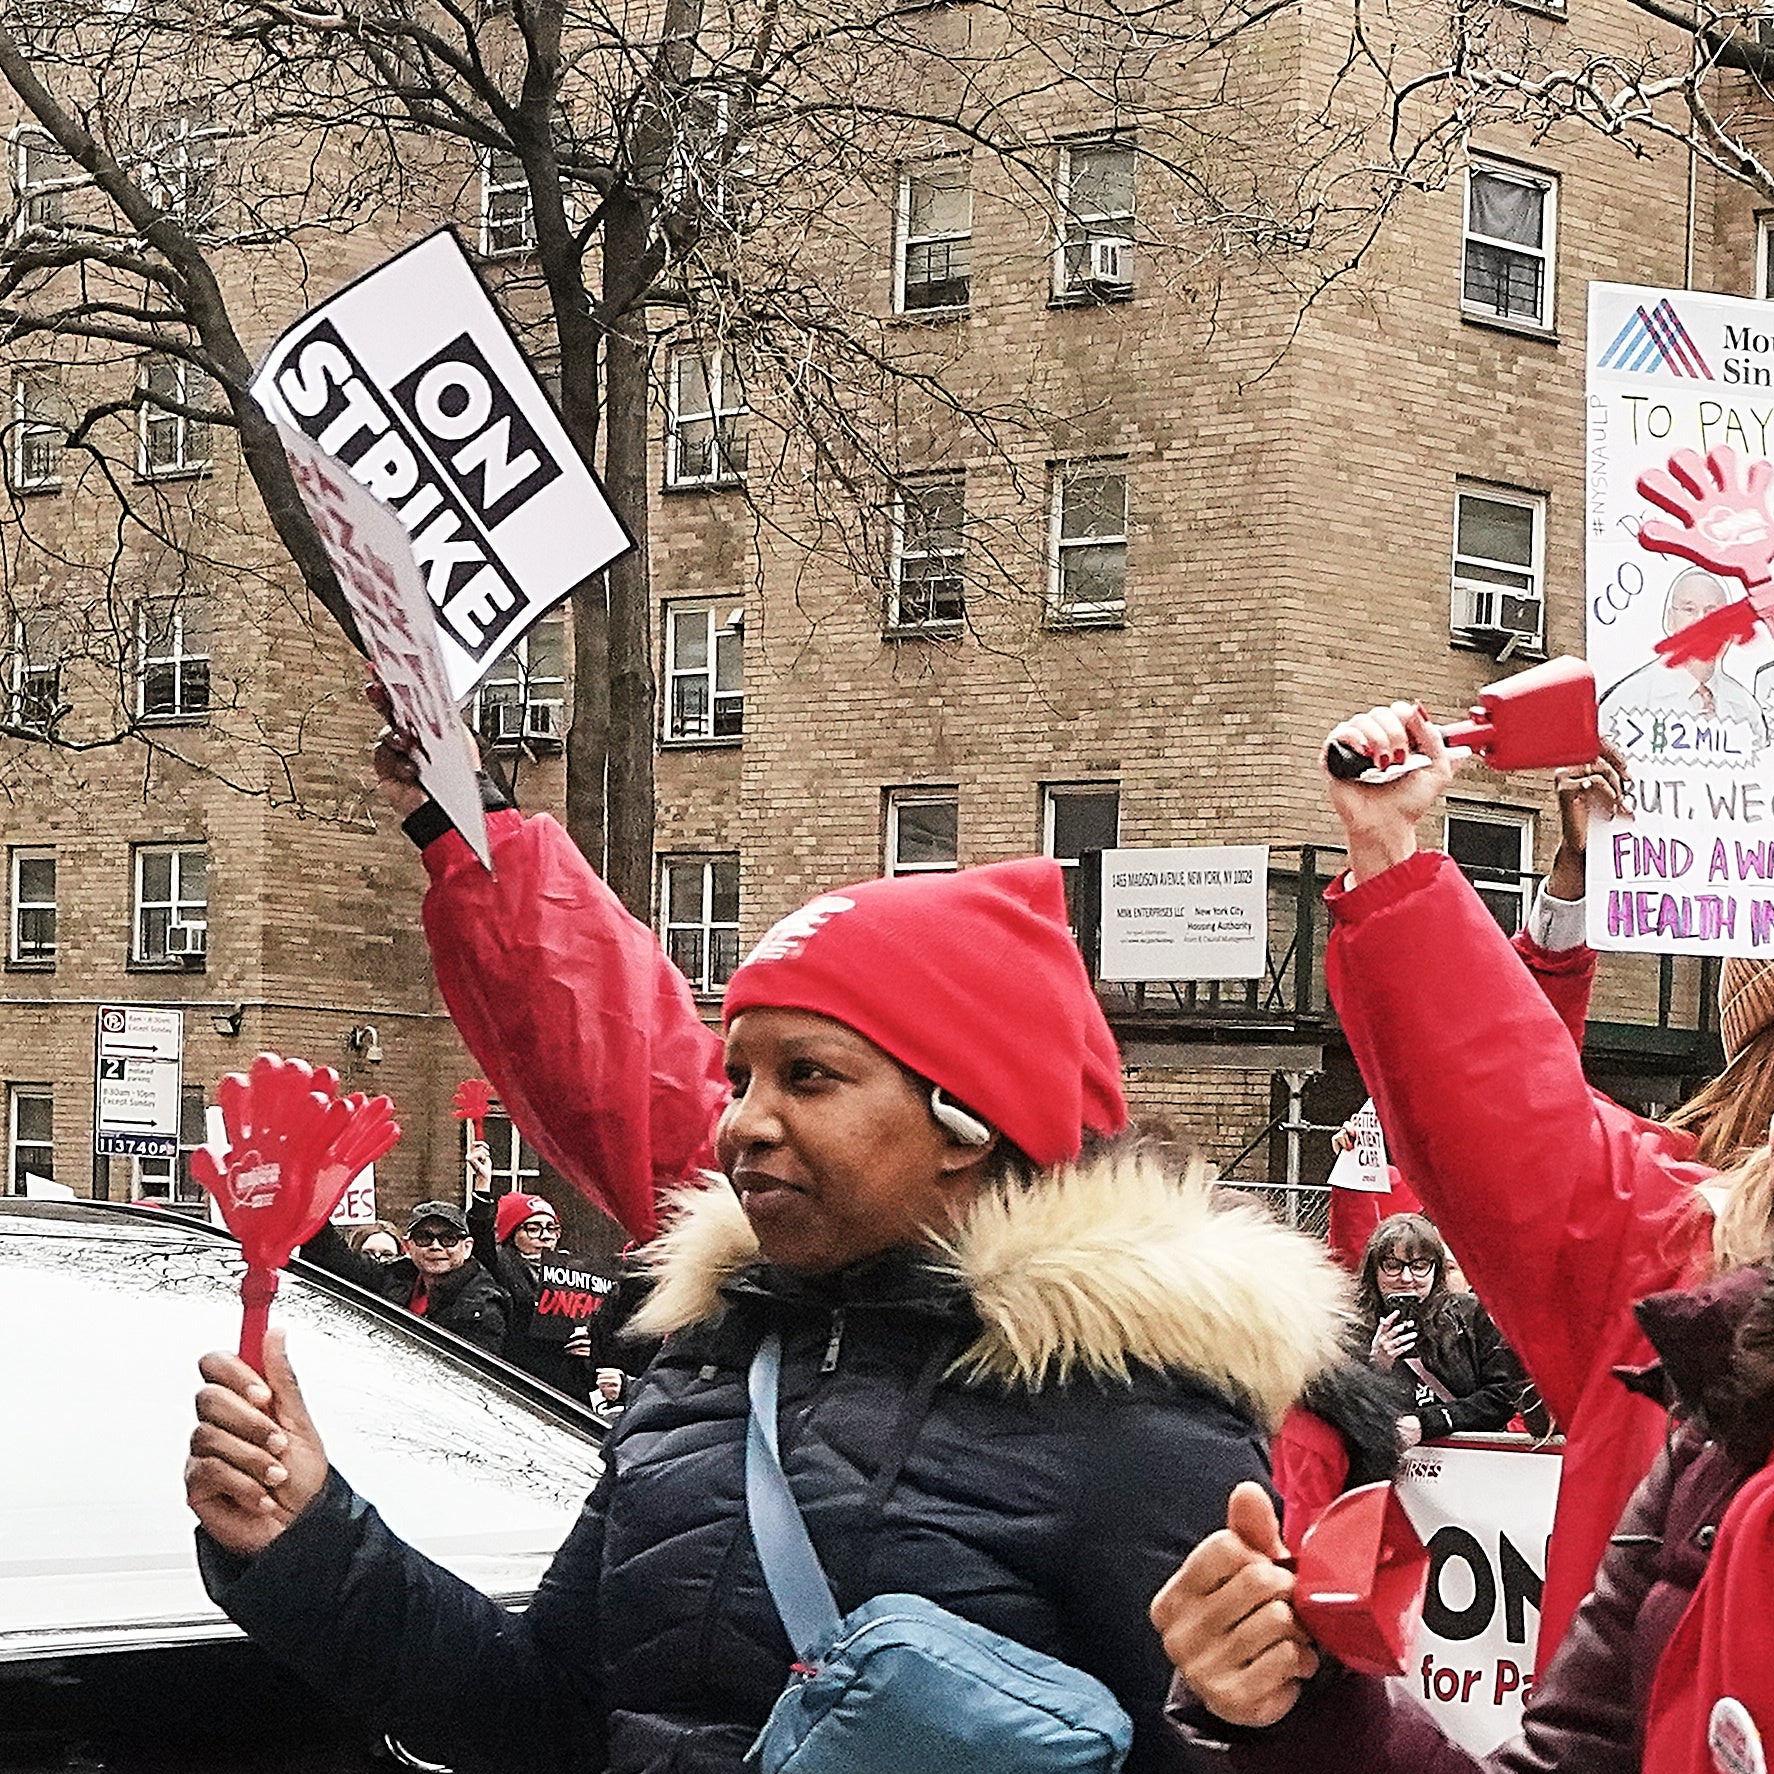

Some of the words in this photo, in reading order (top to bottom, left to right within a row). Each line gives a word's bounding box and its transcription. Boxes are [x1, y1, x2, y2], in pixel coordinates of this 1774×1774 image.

[413, 360, 541, 509] ON
[1621, 395, 1672, 444] TO
[1700, 401, 1774, 456] PAY
[281, 341, 516, 648] STRIKE
[1706, 780, 1764, 823] WE
[1128, 871, 1158, 887] MADISON
[1613, 832, 1694, 880] FIND
[1709, 837, 1729, 883] A
[1217, 921, 1253, 934] Authority
[1608, 889, 1738, 941] HEALTH
[106, 1060, 120, 1079] 2
[543, 1265, 591, 1290] MOUNT
[1405, 1460, 1443, 1477] RSES
[1421, 1655, 1481, 1703] for
